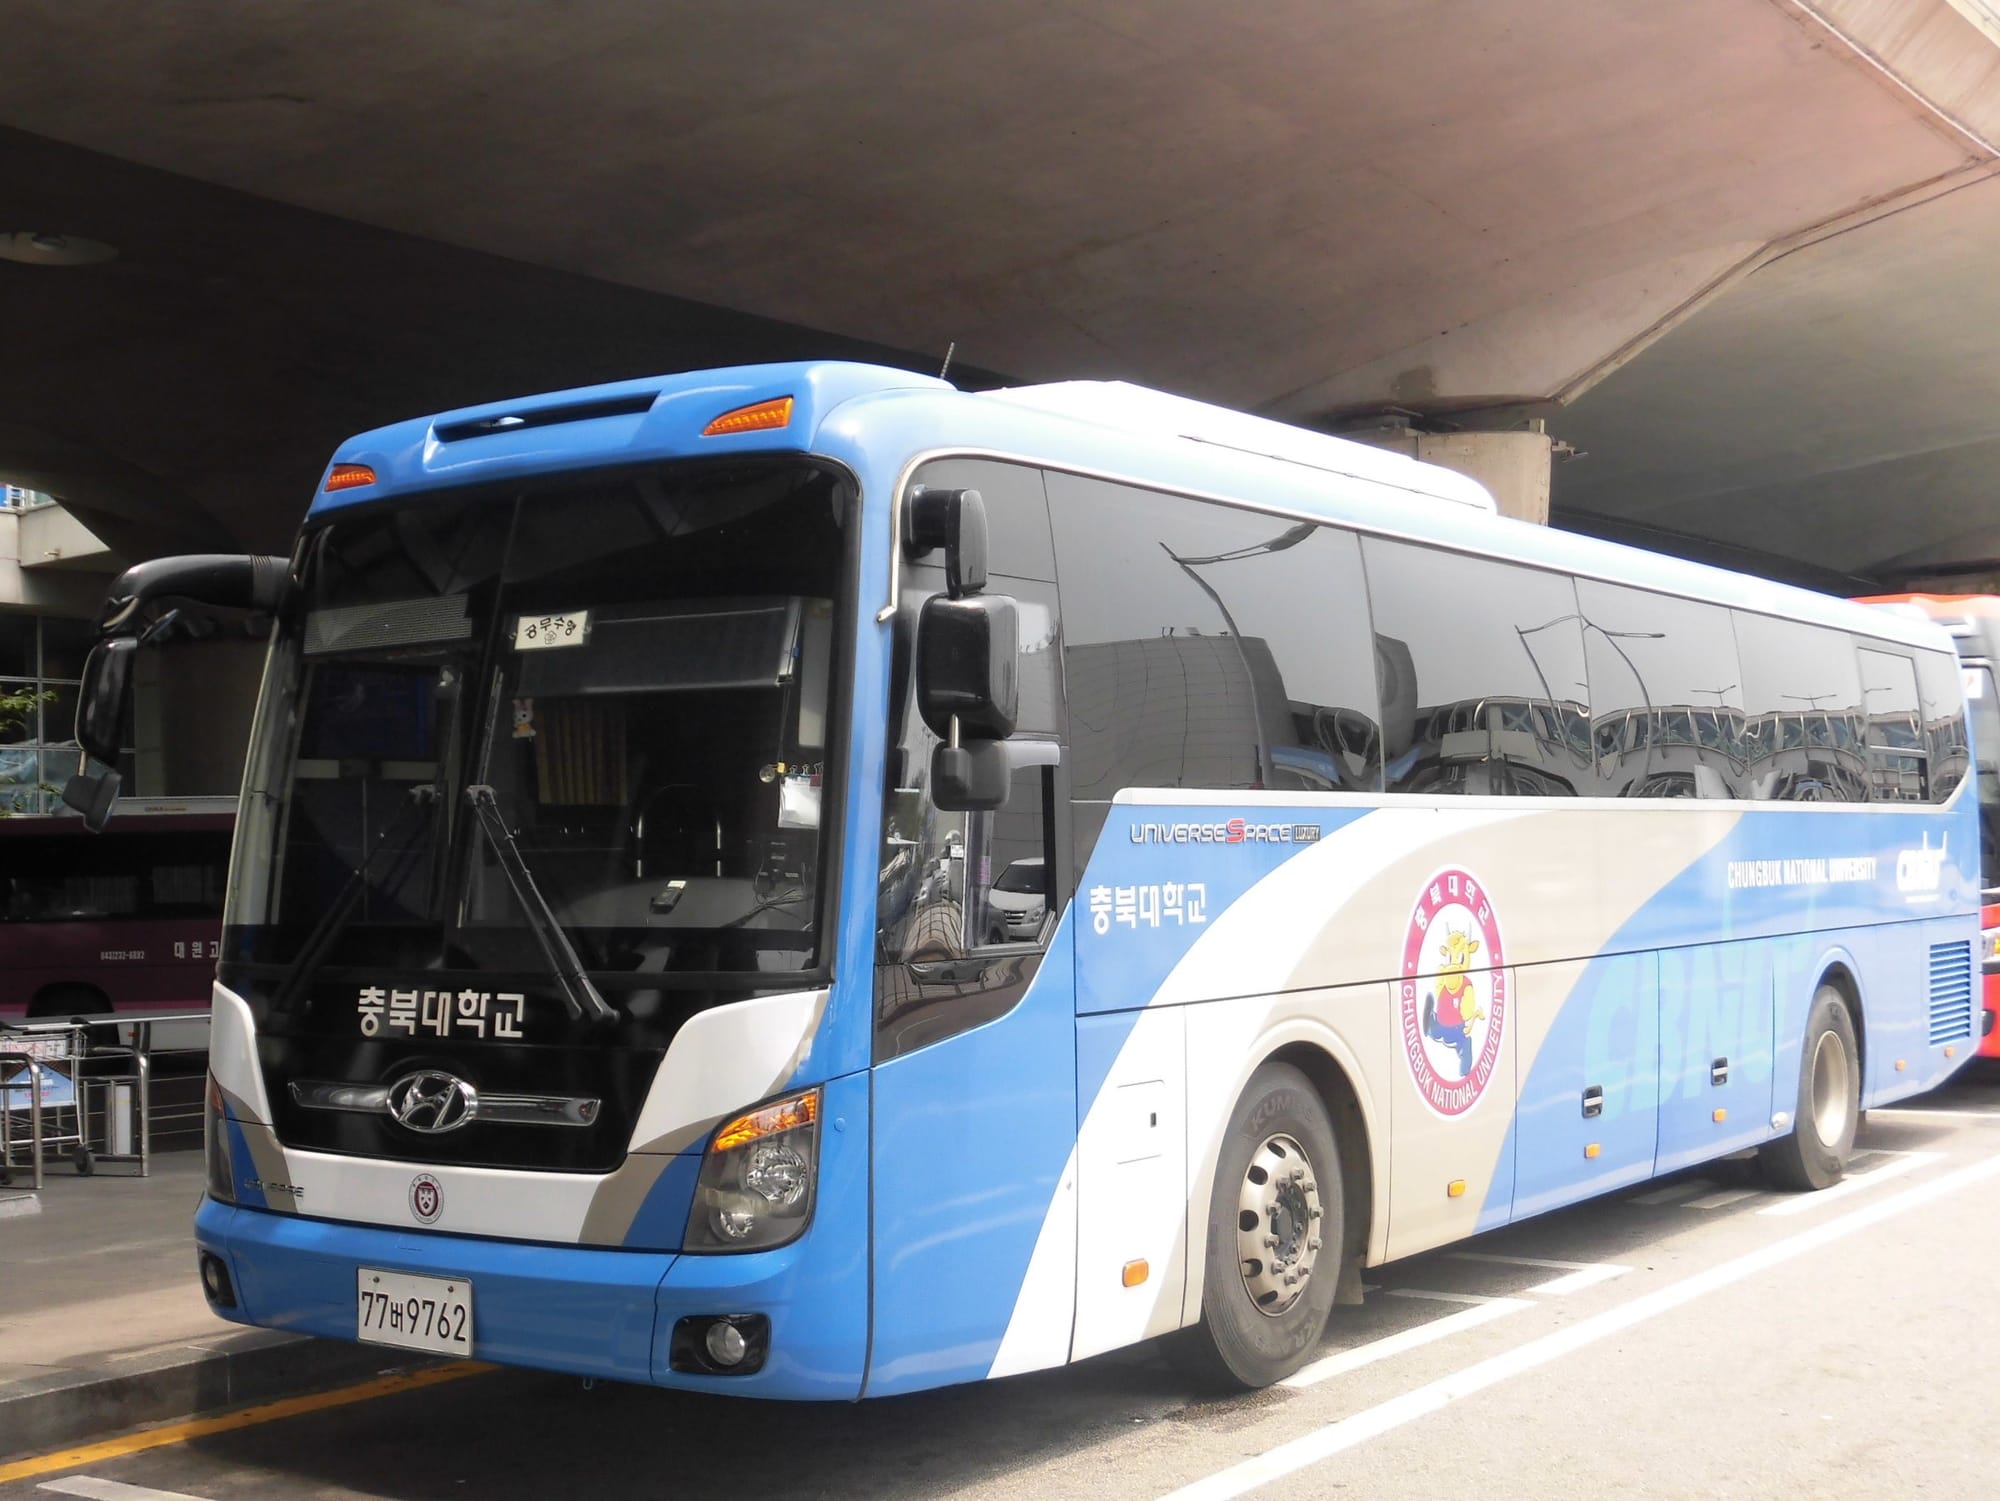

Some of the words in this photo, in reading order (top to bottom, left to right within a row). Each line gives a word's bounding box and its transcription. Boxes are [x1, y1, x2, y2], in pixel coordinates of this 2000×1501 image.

[1728, 861, 1782, 888] CHUNGBUK
[1783, 859, 1828, 884] NATIONAL
[1829, 857, 1877, 882] UNIVERSITY
[1089, 881, 1207, 935] 충북대학교
[1414, 875, 1490, 930] 충북대학교
[357, 986, 525, 1039] 충북대학교
[1402, 984, 1431, 1092] CHUNGBUK
[1430, 1080, 1478, 1109] NATIONAL
[1476, 973, 1504, 1086] UNIVERSITY
[361, 1291, 466, 1342] 77버9762
